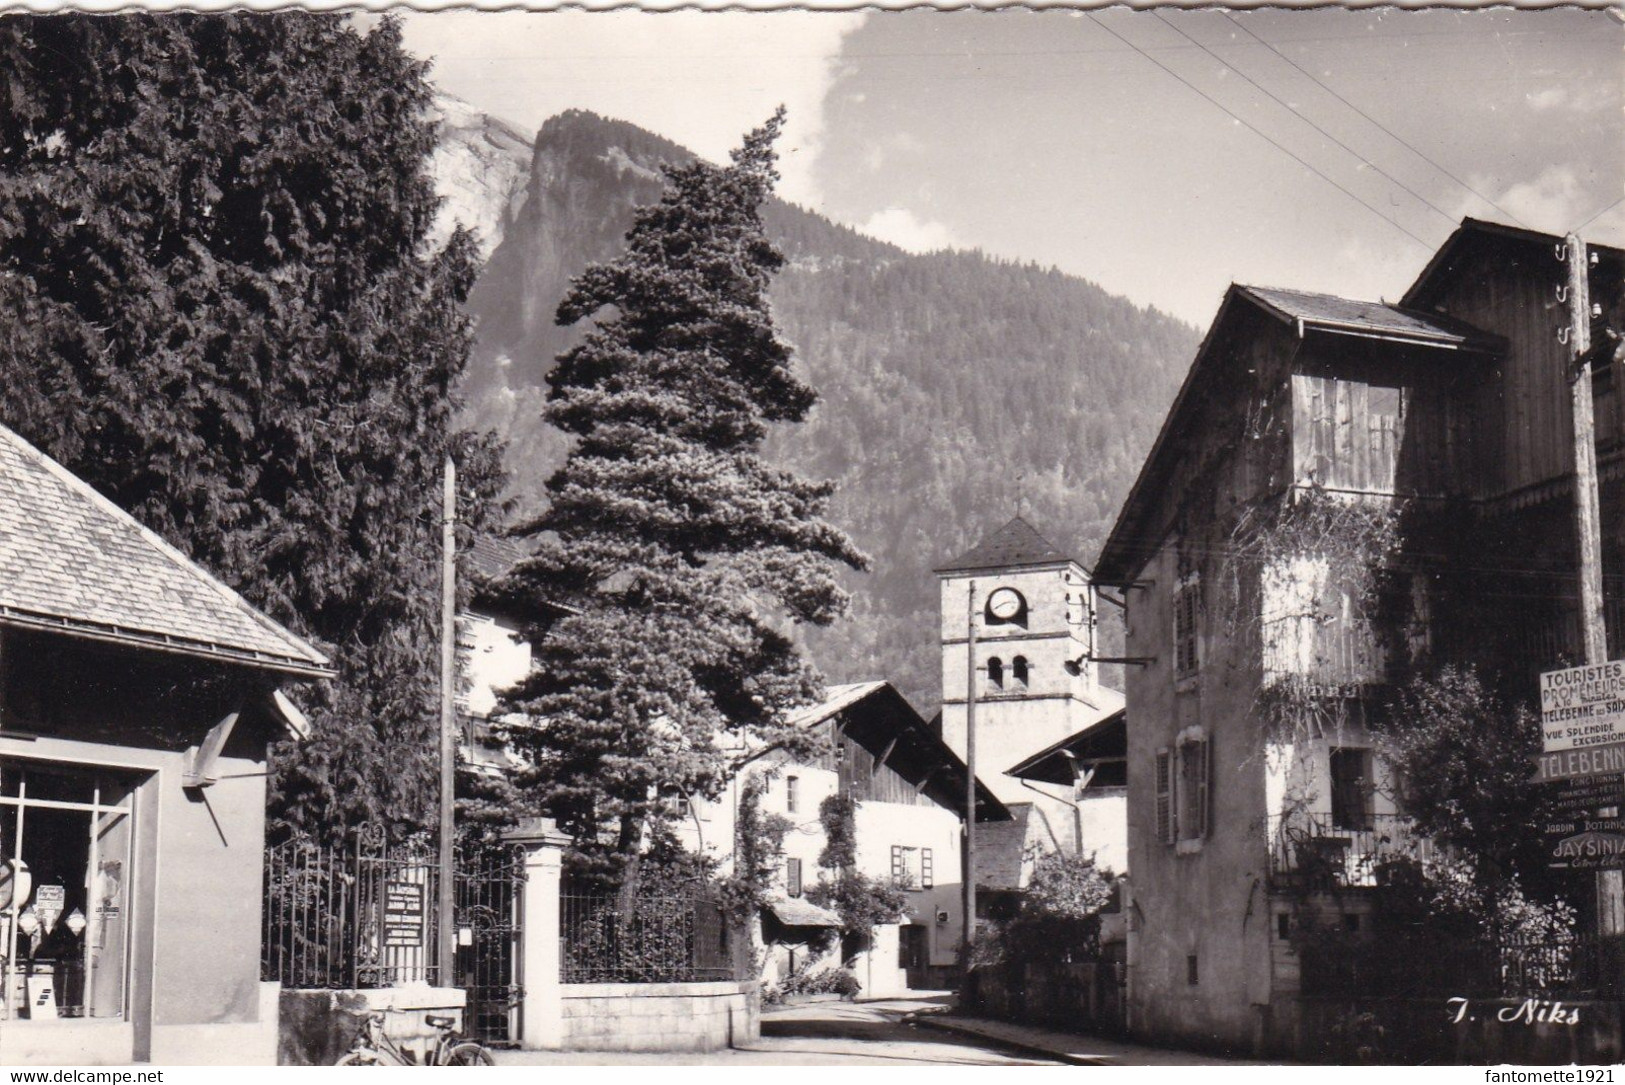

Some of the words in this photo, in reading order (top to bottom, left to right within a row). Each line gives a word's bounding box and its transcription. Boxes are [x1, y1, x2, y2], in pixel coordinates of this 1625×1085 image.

[1546, 664, 1622, 688] TOURISTES
[1546, 729, 1563, 740] VUE
[1572, 732, 1625, 746] EXCURSION
[1545, 823, 1575, 834] JARDIN
